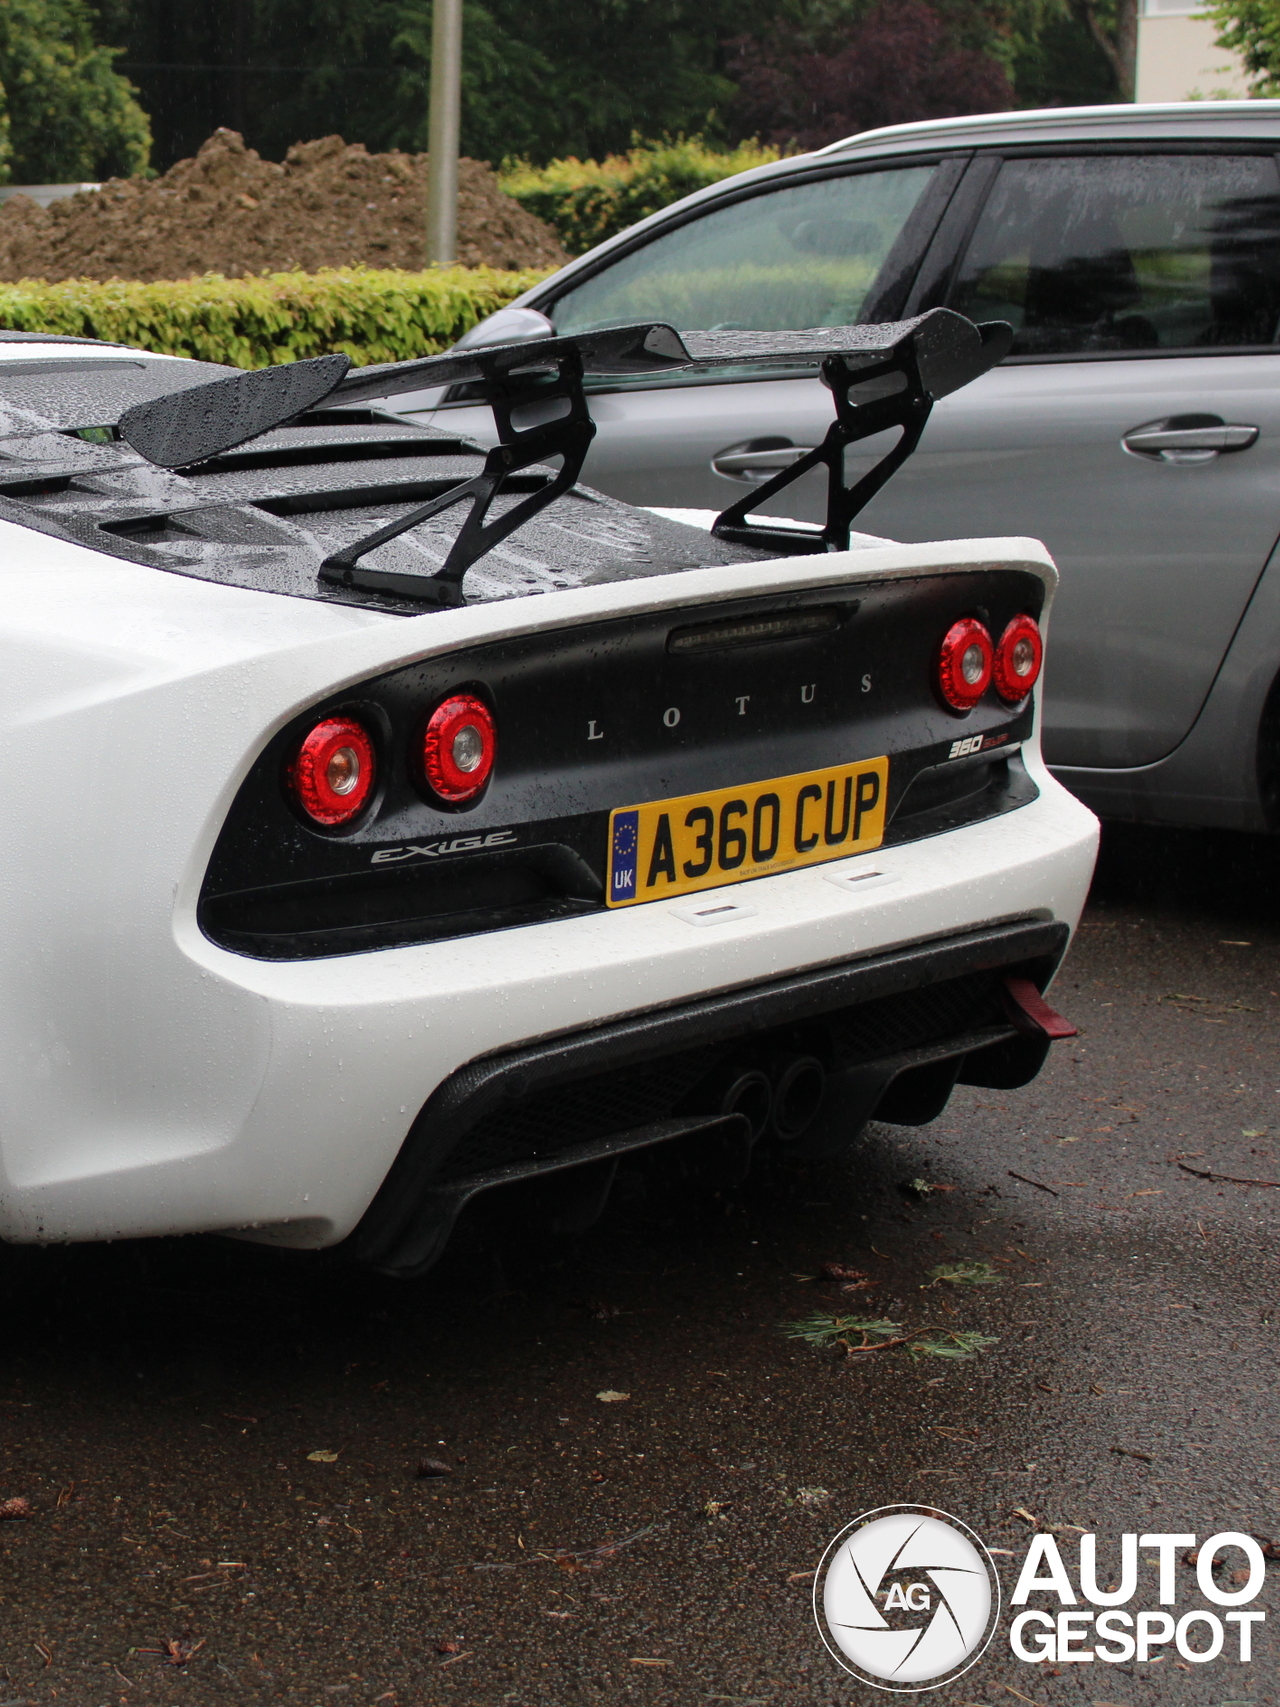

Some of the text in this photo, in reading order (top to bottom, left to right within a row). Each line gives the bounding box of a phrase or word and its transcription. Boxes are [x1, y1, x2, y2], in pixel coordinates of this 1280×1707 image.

[587, 674, 872, 740] LOTUS
[948, 733, 1010, 759] 360 CUP
[646, 771, 880, 887] A360 CUP
[371, 830, 517, 863] EXIGE
[614, 869, 632, 889] UK
